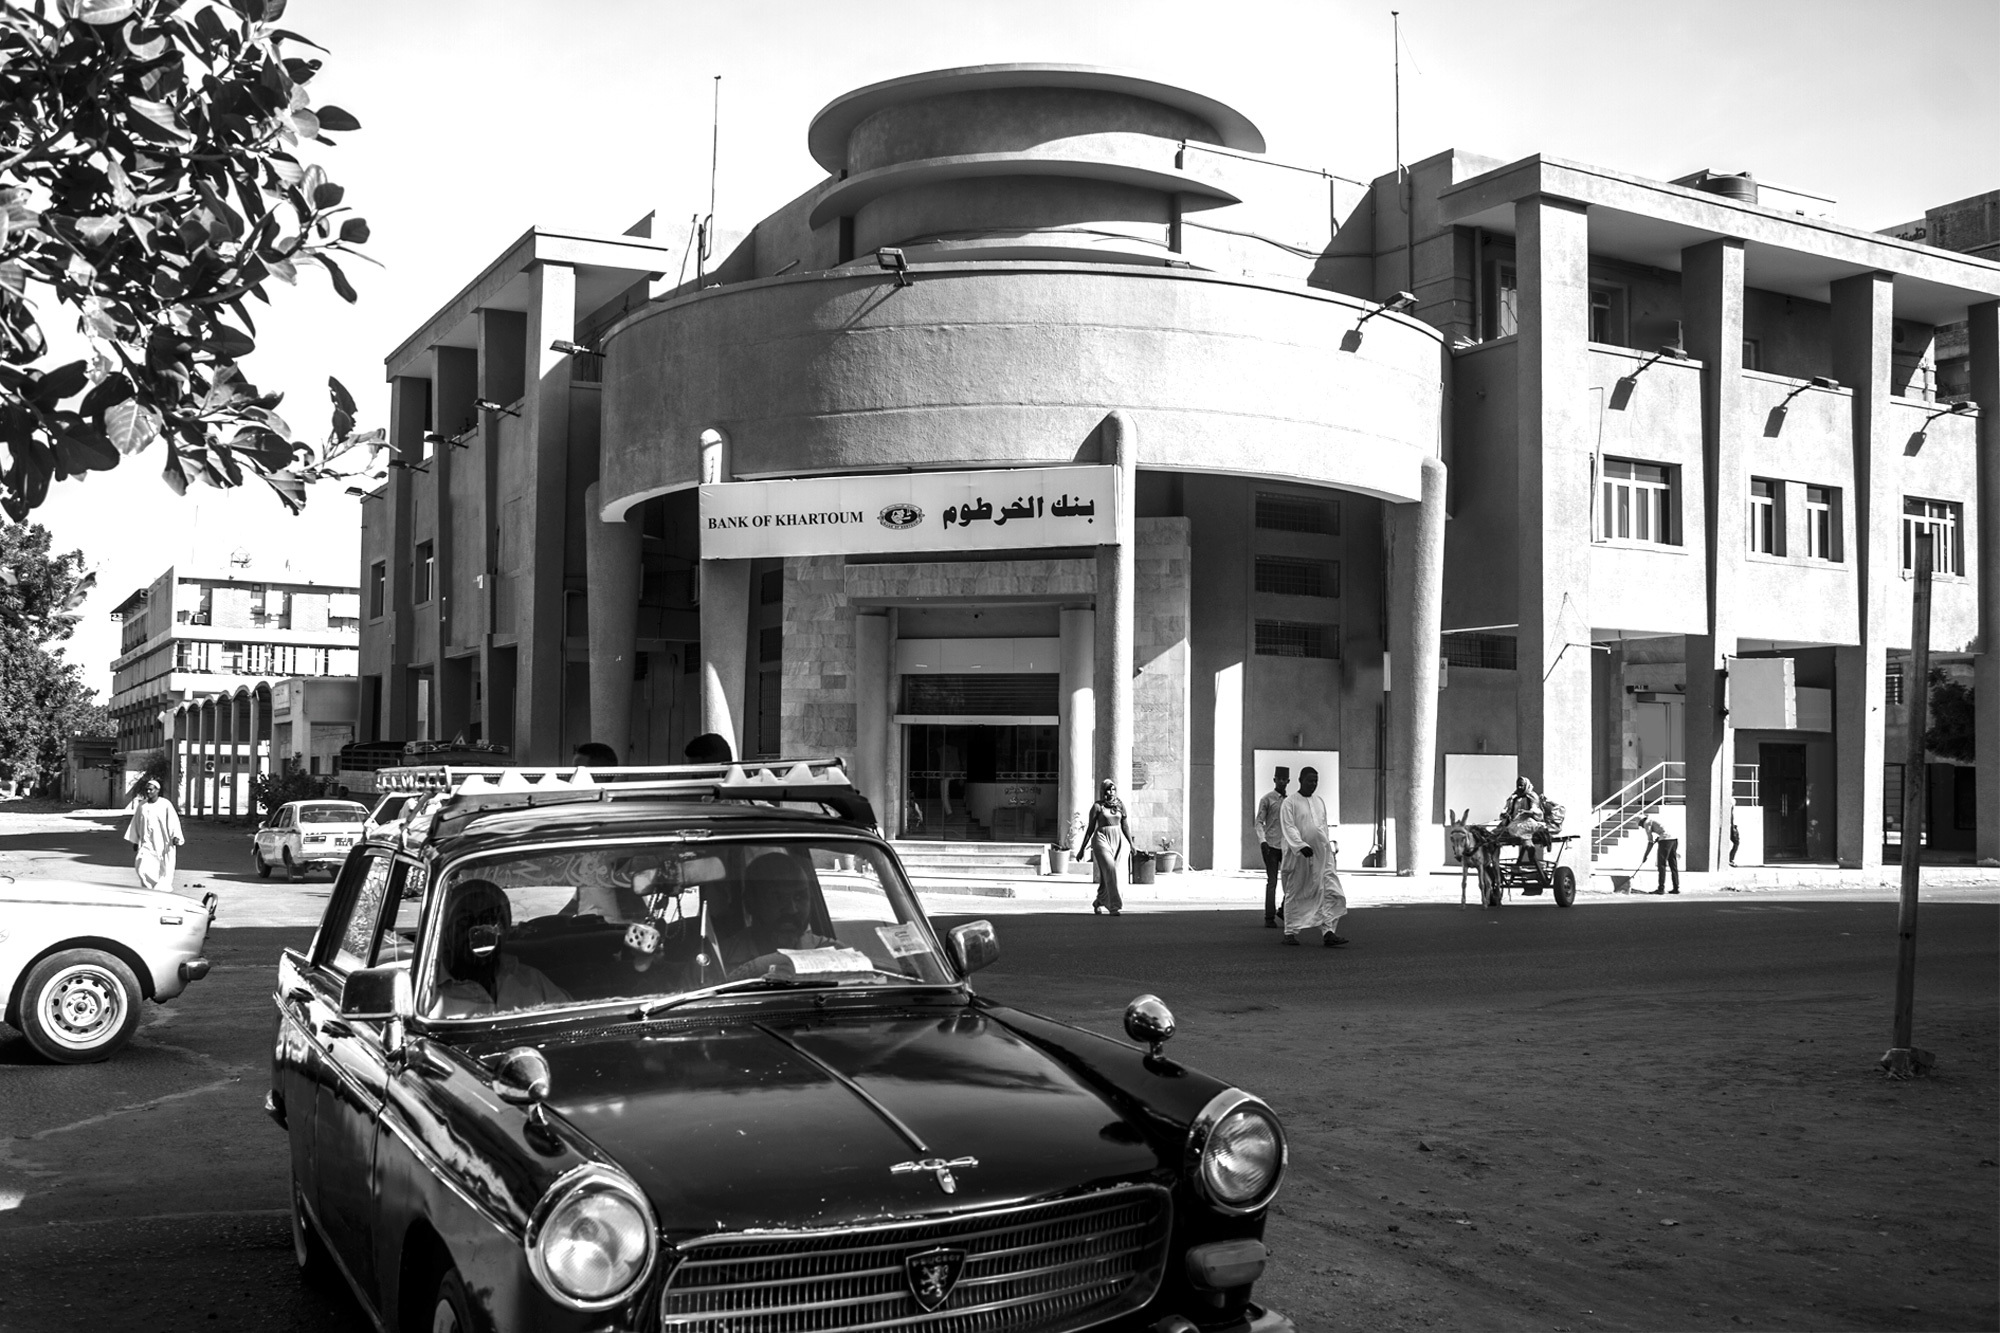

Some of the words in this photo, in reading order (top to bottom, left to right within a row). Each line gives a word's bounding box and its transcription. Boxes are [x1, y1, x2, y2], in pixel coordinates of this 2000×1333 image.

[708, 516, 749, 530] BANK
[752, 515, 773, 528] OF
[775, 511, 864, 527] KHARTOUM
[943, 495, 1044, 530] الخرطوم
[1051, 494, 1095, 524] بنك
[889, 1156, 979, 1175] 404
